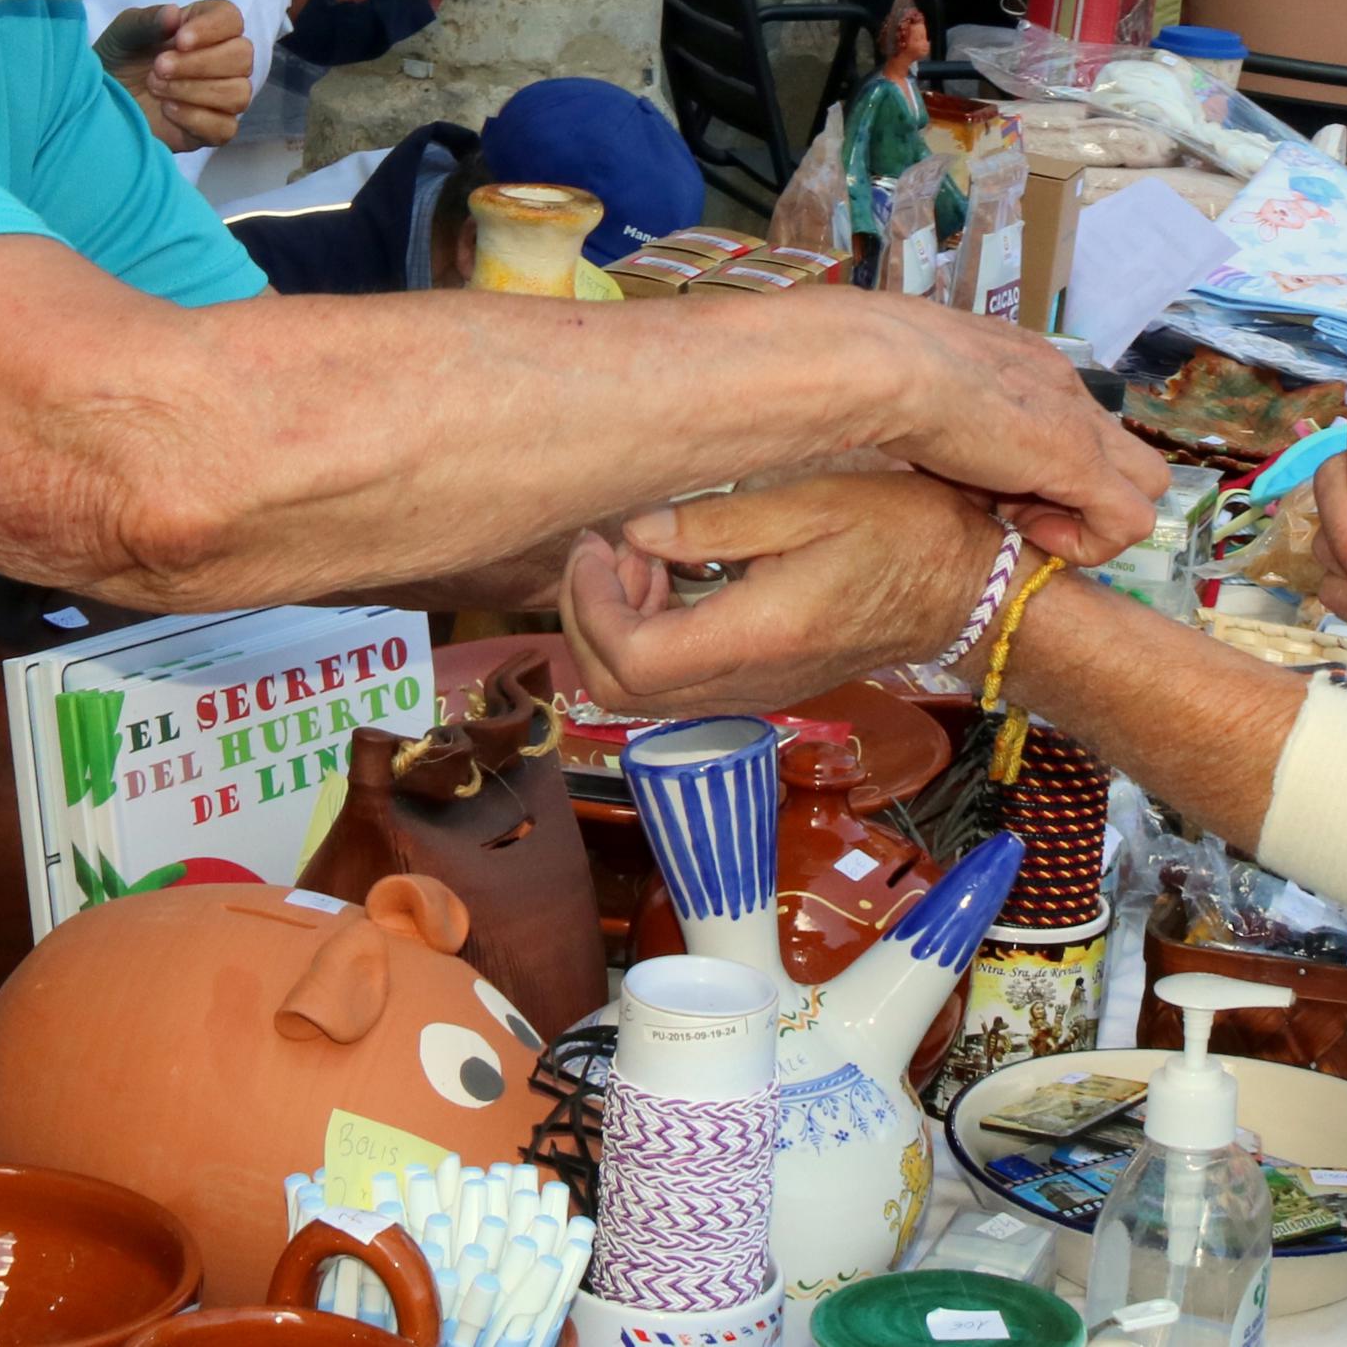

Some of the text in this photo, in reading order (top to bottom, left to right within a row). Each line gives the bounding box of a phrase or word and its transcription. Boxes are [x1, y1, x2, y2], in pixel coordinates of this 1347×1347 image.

[989, 286, 1020, 314] CACAO
[126, 636, 408, 753] EL SECRETO
[124, 676, 420, 802] DEL HUERTO
[190, 783, 240, 826] DE
[979, 962, 1005, 976] Ntra.
[1010, 966, 1030, 978] Sra.
[1034, 966, 1047, 978] de
[652, 1025, 737, 1042] PU-2015-09-19-24
[339, 1122, 399, 1166] BOLIS
